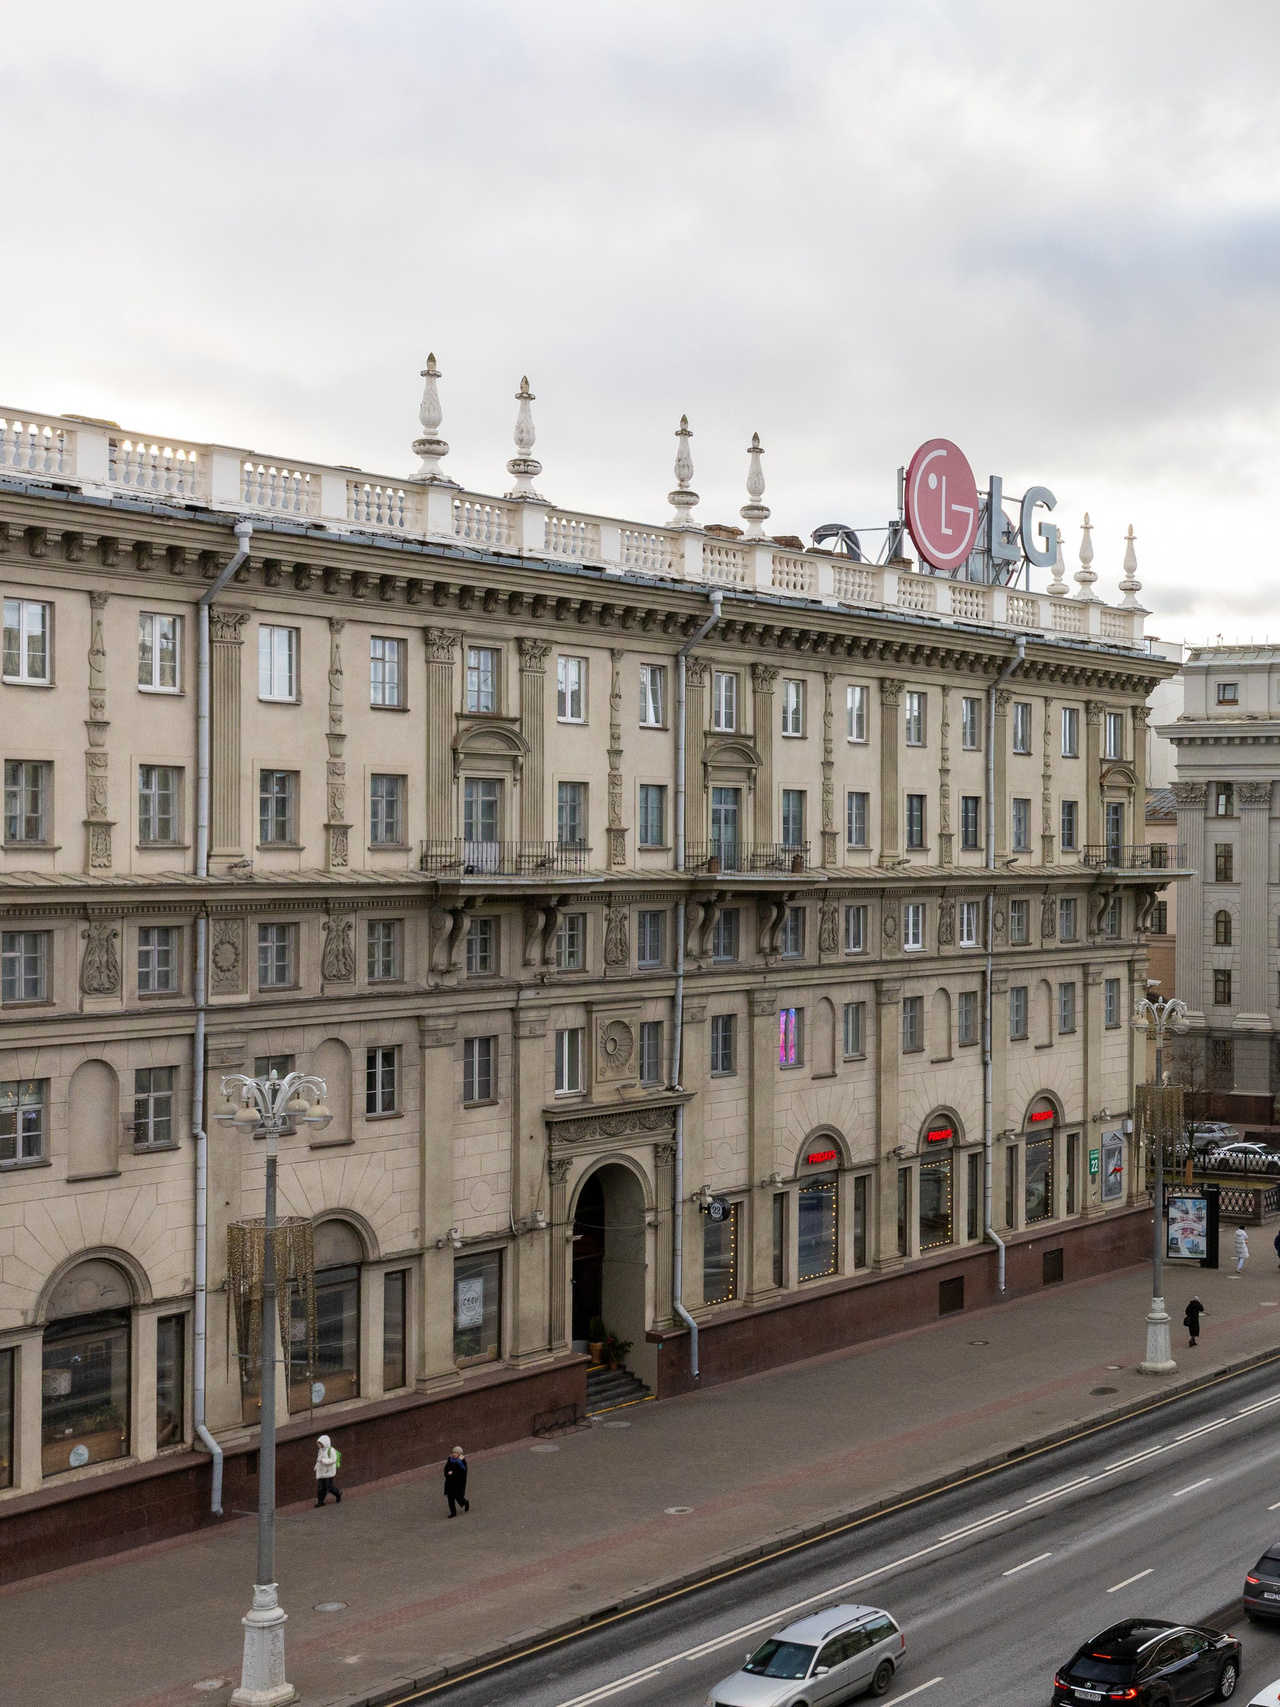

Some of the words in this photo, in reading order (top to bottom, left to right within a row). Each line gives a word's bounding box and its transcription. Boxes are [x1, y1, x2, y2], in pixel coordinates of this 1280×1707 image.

[987, 475, 1057, 567] LG
[928, 1128, 953, 1141] FRIDAYS
[808, 1149, 837, 1164] FRIDAYS
[1091, 1159, 1098, 1172] 22
[712, 1205, 721, 1215] 22
